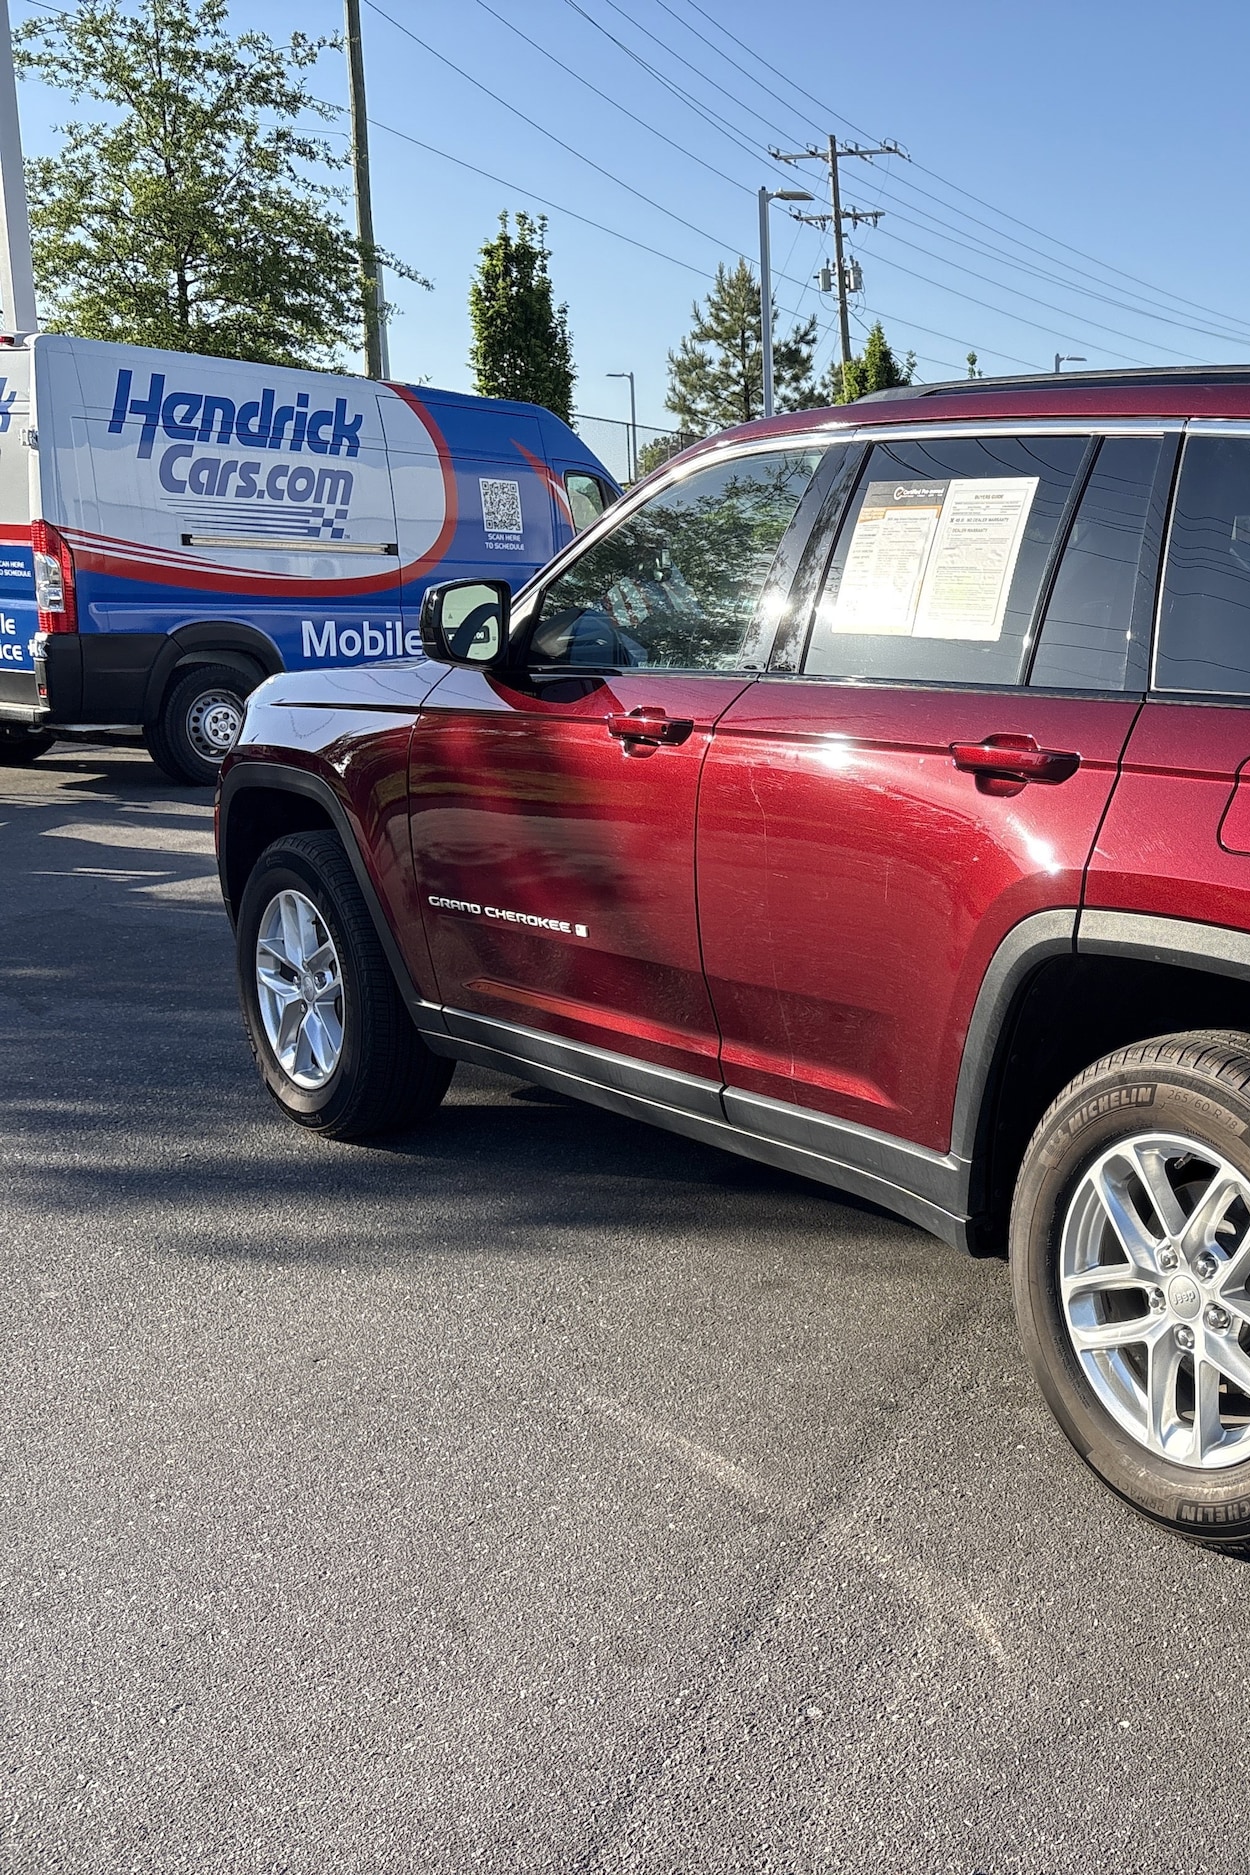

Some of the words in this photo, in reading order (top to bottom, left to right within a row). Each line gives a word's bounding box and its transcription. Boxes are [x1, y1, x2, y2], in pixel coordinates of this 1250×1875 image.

[108, 369, 363, 459] Hendrick
[159, 444, 353, 506] Cars.com
[487, 533, 504, 541] SCAN
[505, 534, 521, 542] HERE
[494, 542, 525, 551] SCHEDULE
[301, 620, 423, 658] Mobile
[428, 895, 482, 915] GRAND
[484, 906, 572, 934] CHEROKEE
[1068, 1087, 1152, 1133] MICHELIN
[1166, 1089, 1211, 1113] 265/60
[1212, 1108, 1222, 1119] R
[1224, 1116, 1239, 1131] 18
[1173, 1290, 1196, 1306] Jeep
